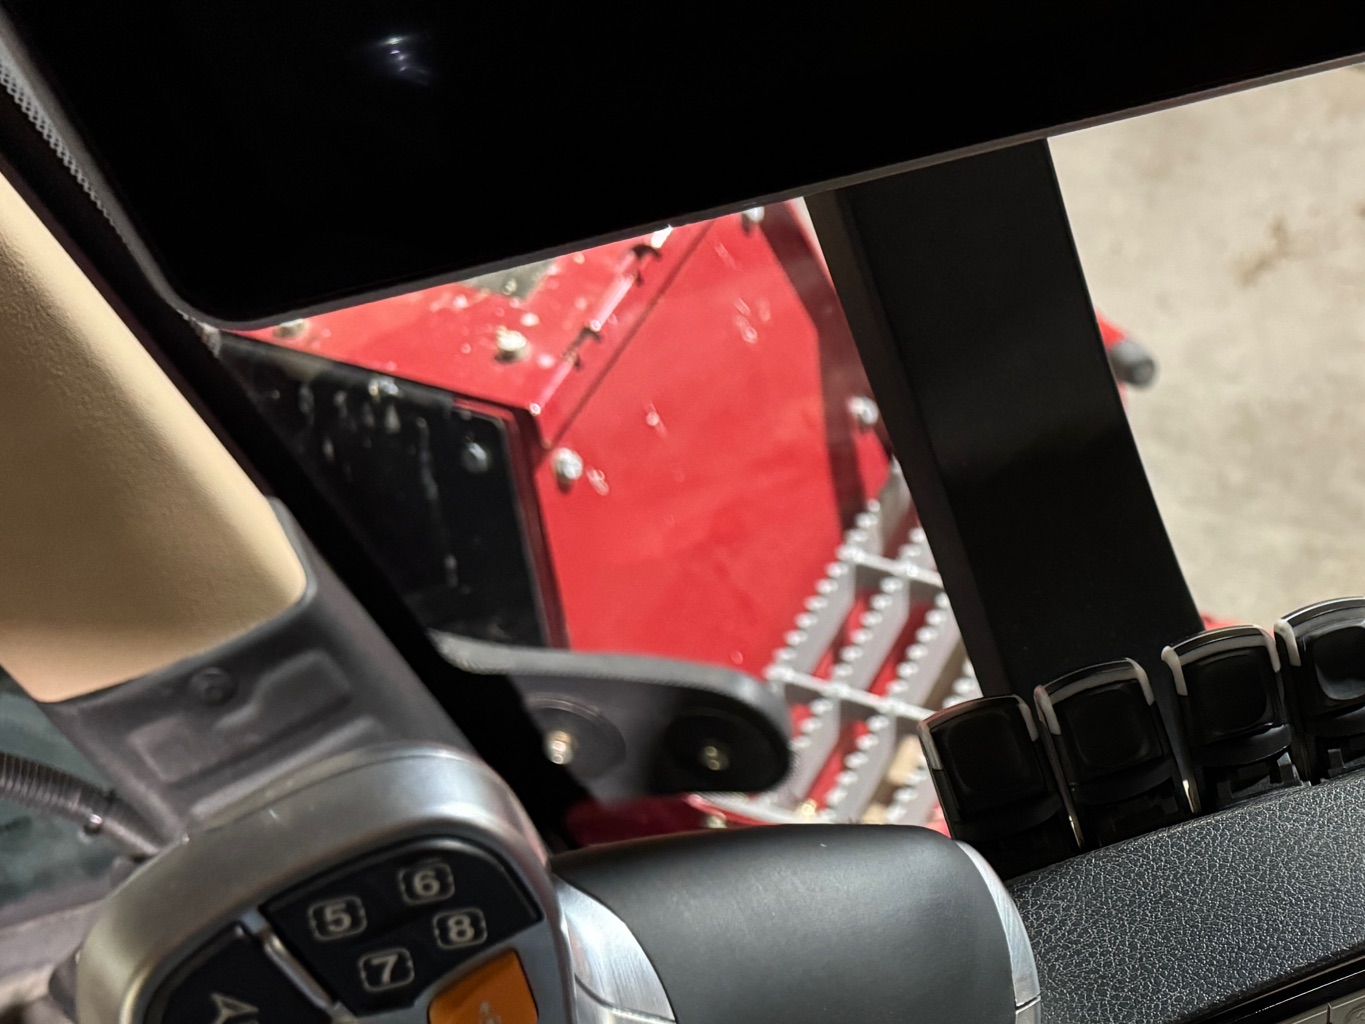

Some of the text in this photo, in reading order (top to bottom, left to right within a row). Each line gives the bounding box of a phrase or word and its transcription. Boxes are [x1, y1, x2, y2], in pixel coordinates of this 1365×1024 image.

[413, 871, 441, 899] 6
[324, 901, 352, 932] 5
[449, 914, 475, 945] 8
[374, 954, 398, 984] 7
